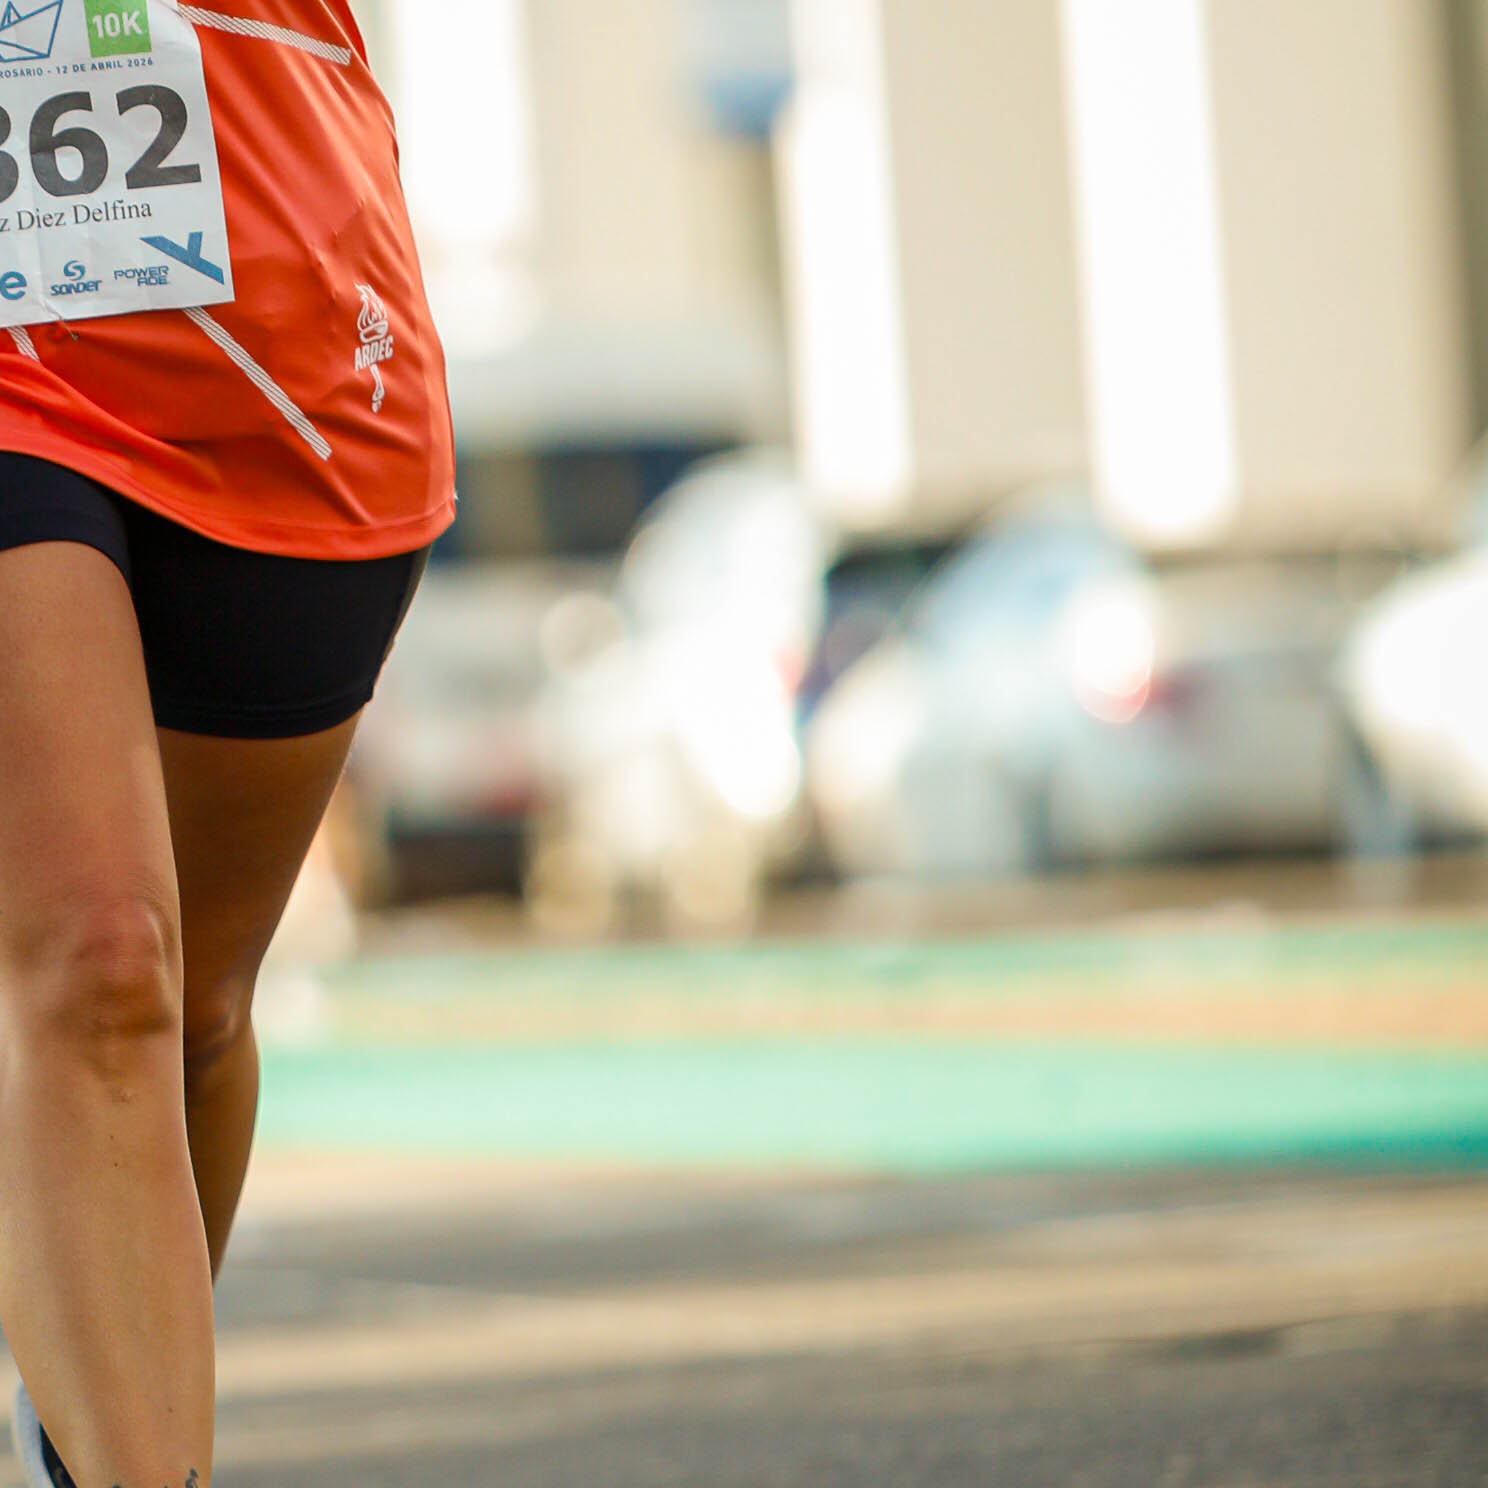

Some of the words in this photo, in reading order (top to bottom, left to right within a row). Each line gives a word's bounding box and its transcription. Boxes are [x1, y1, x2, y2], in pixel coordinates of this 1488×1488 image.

[92, 10, 143, 38] 10K
[56, 65, 68, 74] 12
[73, 63, 86, 73] DE
[90, 60, 123, 71] ABRIL
[127, 57, 153, 68] 2026
[16, 208, 66, 231] Diez
[73, 199, 152, 225] Delfina
[113, 265, 169, 281] POWER
[354, 335, 395, 373] ARDEC
